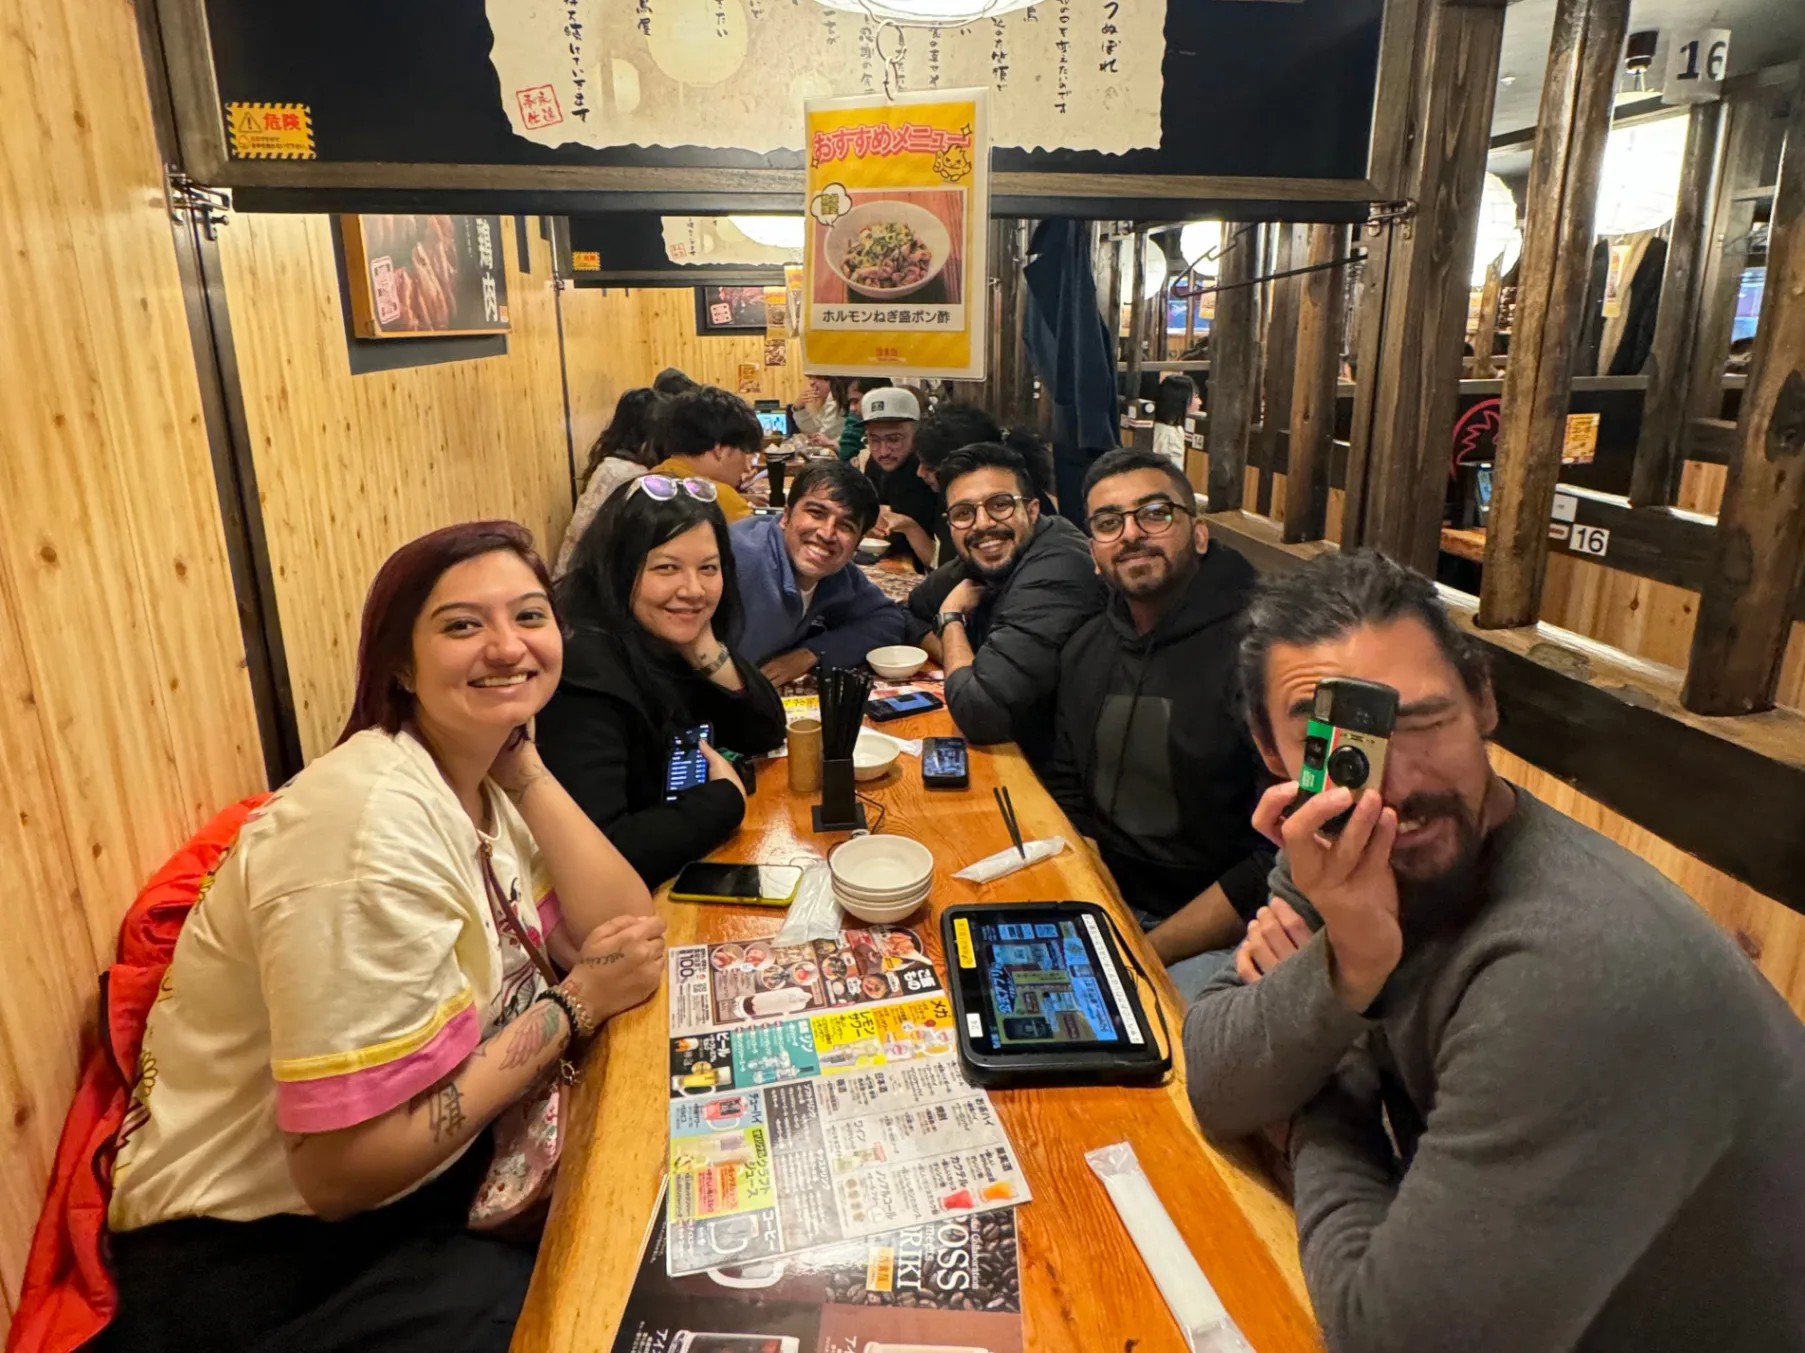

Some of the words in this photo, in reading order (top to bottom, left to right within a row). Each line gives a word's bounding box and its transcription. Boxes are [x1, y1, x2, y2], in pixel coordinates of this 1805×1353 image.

[1675, 40, 1727, 81] 16
[263, 112, 301, 131] 危険
[813, 121, 971, 163] おすすめメニュー
[822, 309, 951, 324] ホルモンねぎ盛ポン酢
[1577, 528, 1606, 553] 16
[849, 1013, 862, 1038] サワー
[860, 1011, 875, 1036] レモン
[716, 1032, 730, 1057] ビール
[800, 1034, 813, 1052] ジン
[874, 1072, 889, 1093] 日本酒
[748, 1092, 762, 1124] チューハイ
[854, 1120, 866, 1142] ワイン
[744, 1161, 758, 1199] ジュース
[756, 1159, 771, 1195] クラフト
[950, 1155, 969, 1188] カクテル
[875, 1170, 897, 1220] ノンアルコール
[762, 1210, 776, 1251] コーヒー
[924, 1224, 936, 1262] meets
[897, 1226, 924, 1291] RIKI
[970, 1233, 980, 1290] Collaboration
